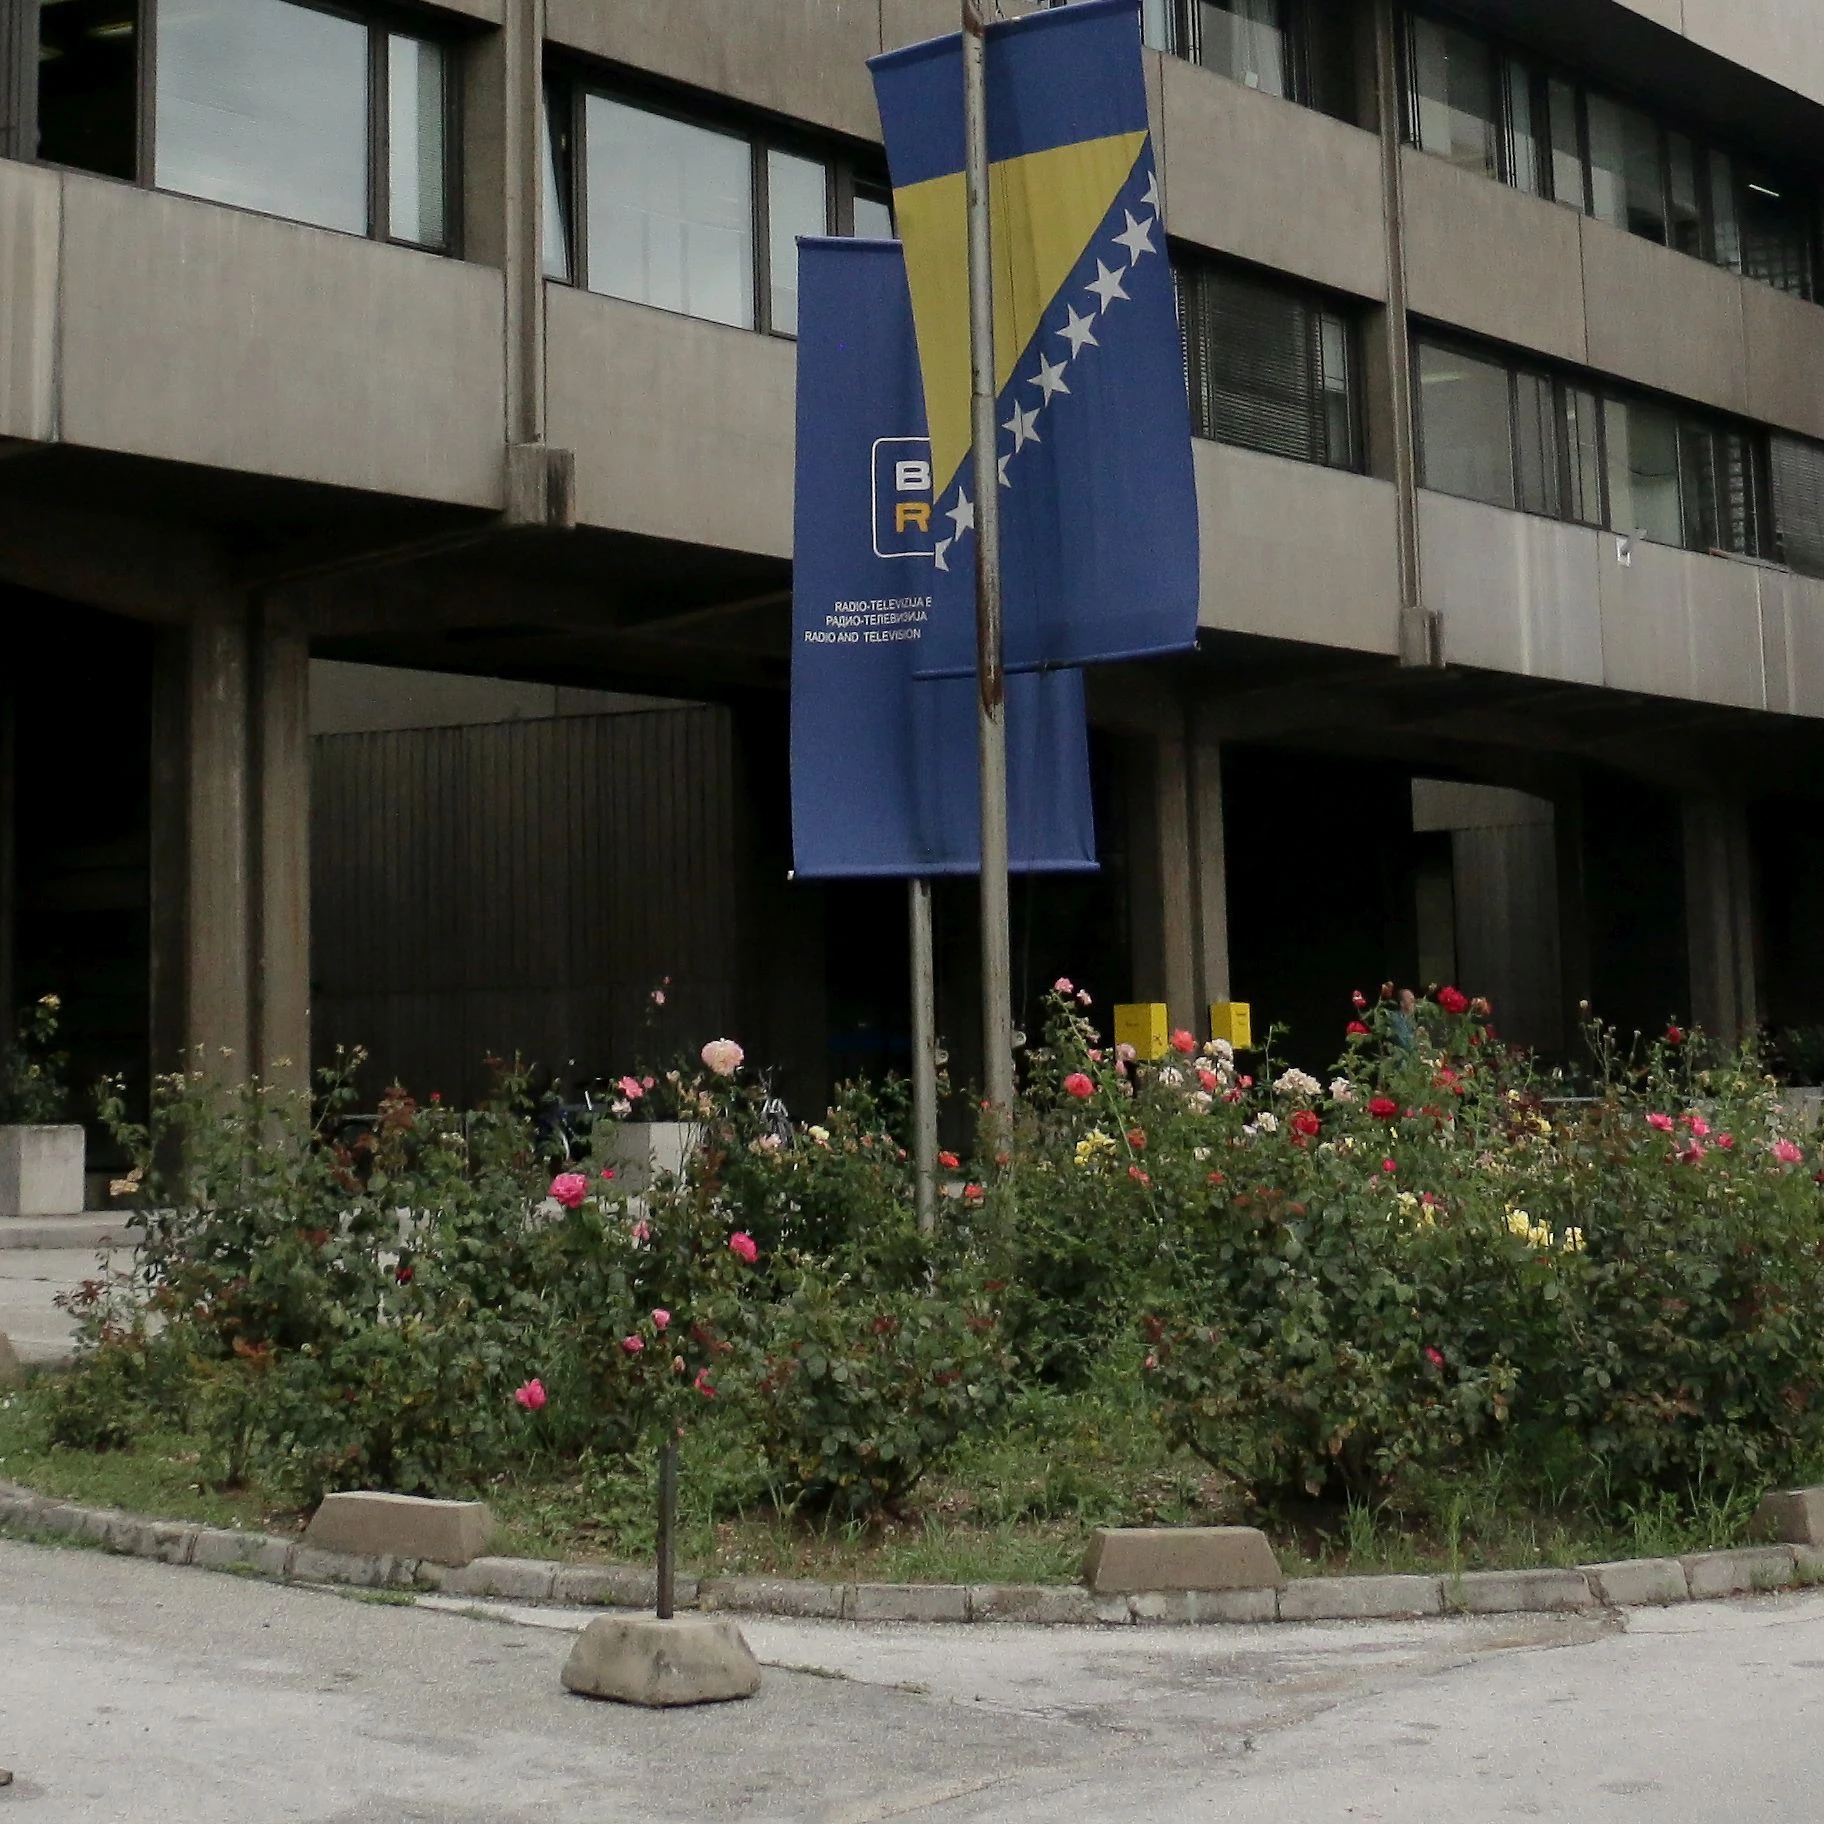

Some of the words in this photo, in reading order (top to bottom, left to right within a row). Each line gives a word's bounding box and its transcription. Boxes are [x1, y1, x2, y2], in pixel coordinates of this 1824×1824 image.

[834, 598, 924, 612] RADIO-TELEVIZIJA
[804, 630, 836, 643] RADIO
[837, 631, 859, 643] AND
[863, 628, 921, 643] TELEVISION
